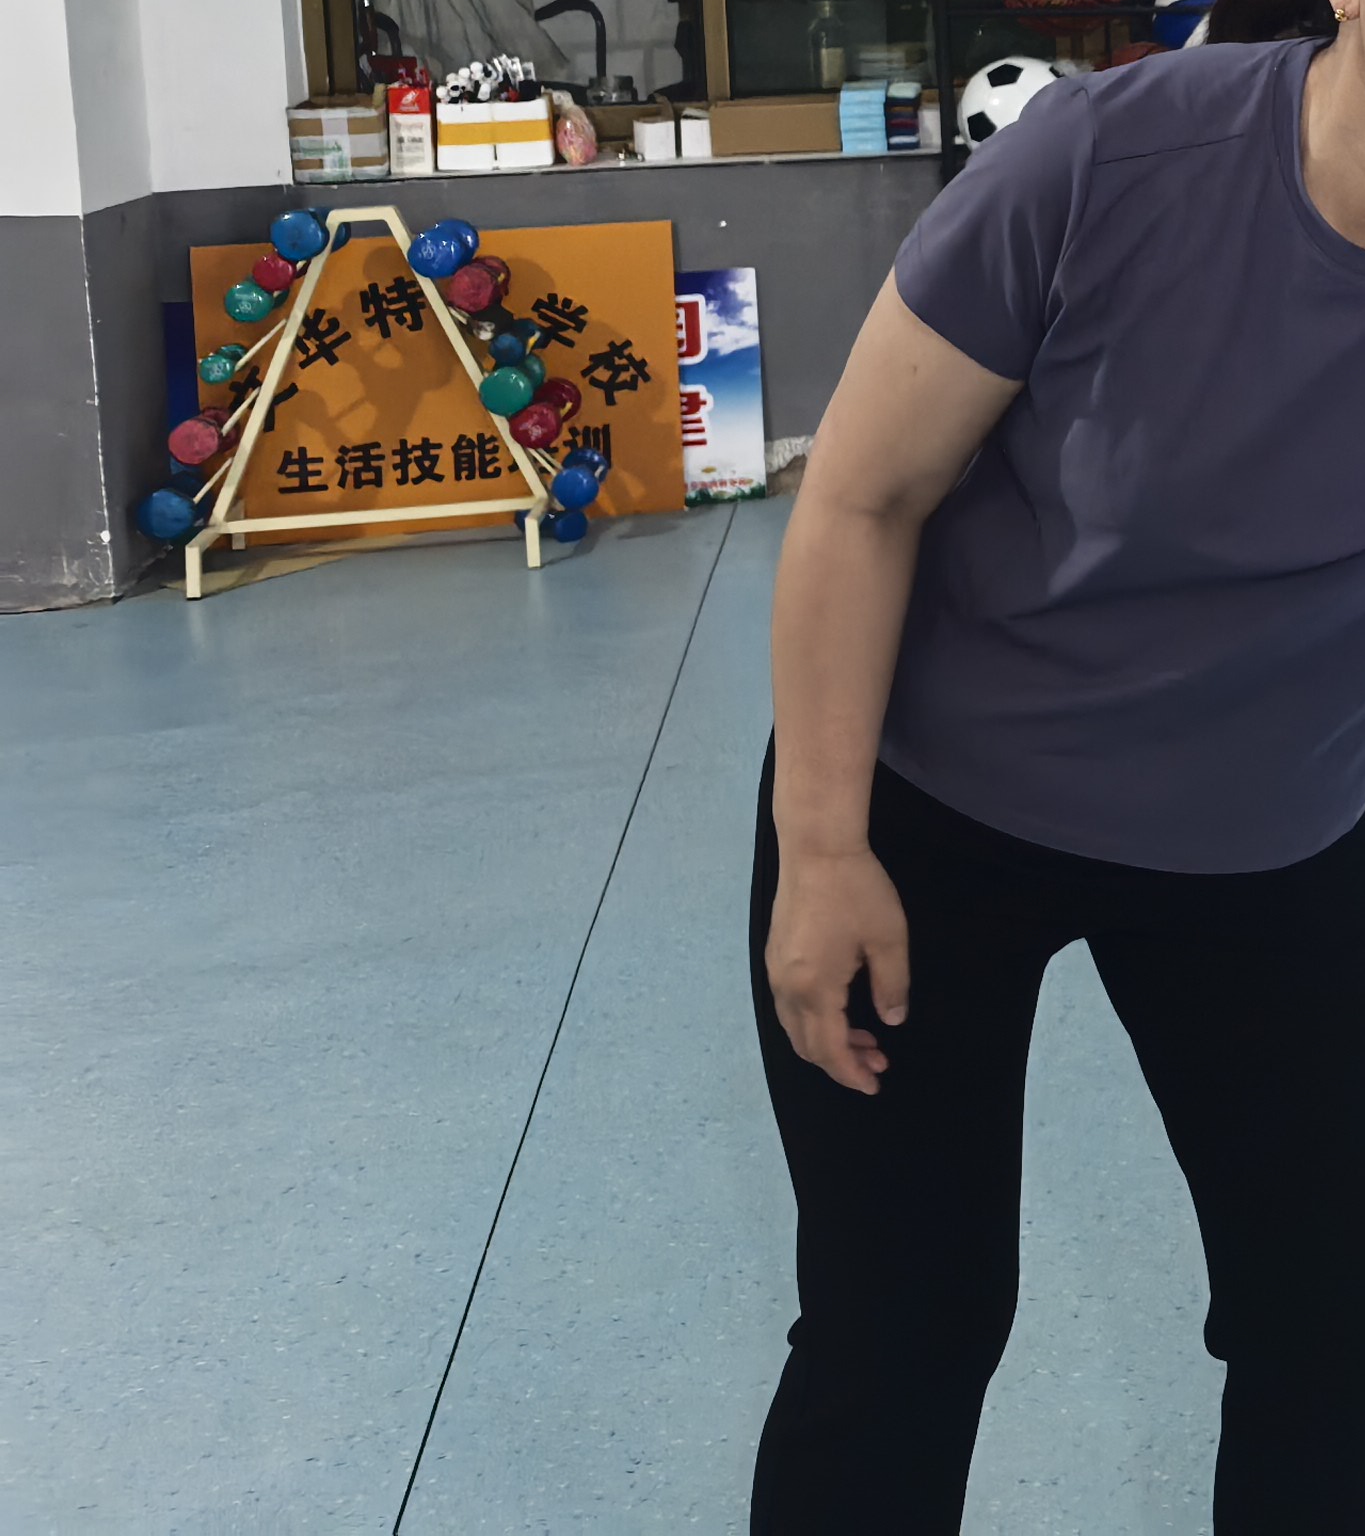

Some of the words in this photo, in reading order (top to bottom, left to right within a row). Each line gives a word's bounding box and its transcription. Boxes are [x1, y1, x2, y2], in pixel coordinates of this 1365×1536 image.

[229, 276, 652, 432] 文华特学校
[276, 424, 611, 495] 生活技能训
